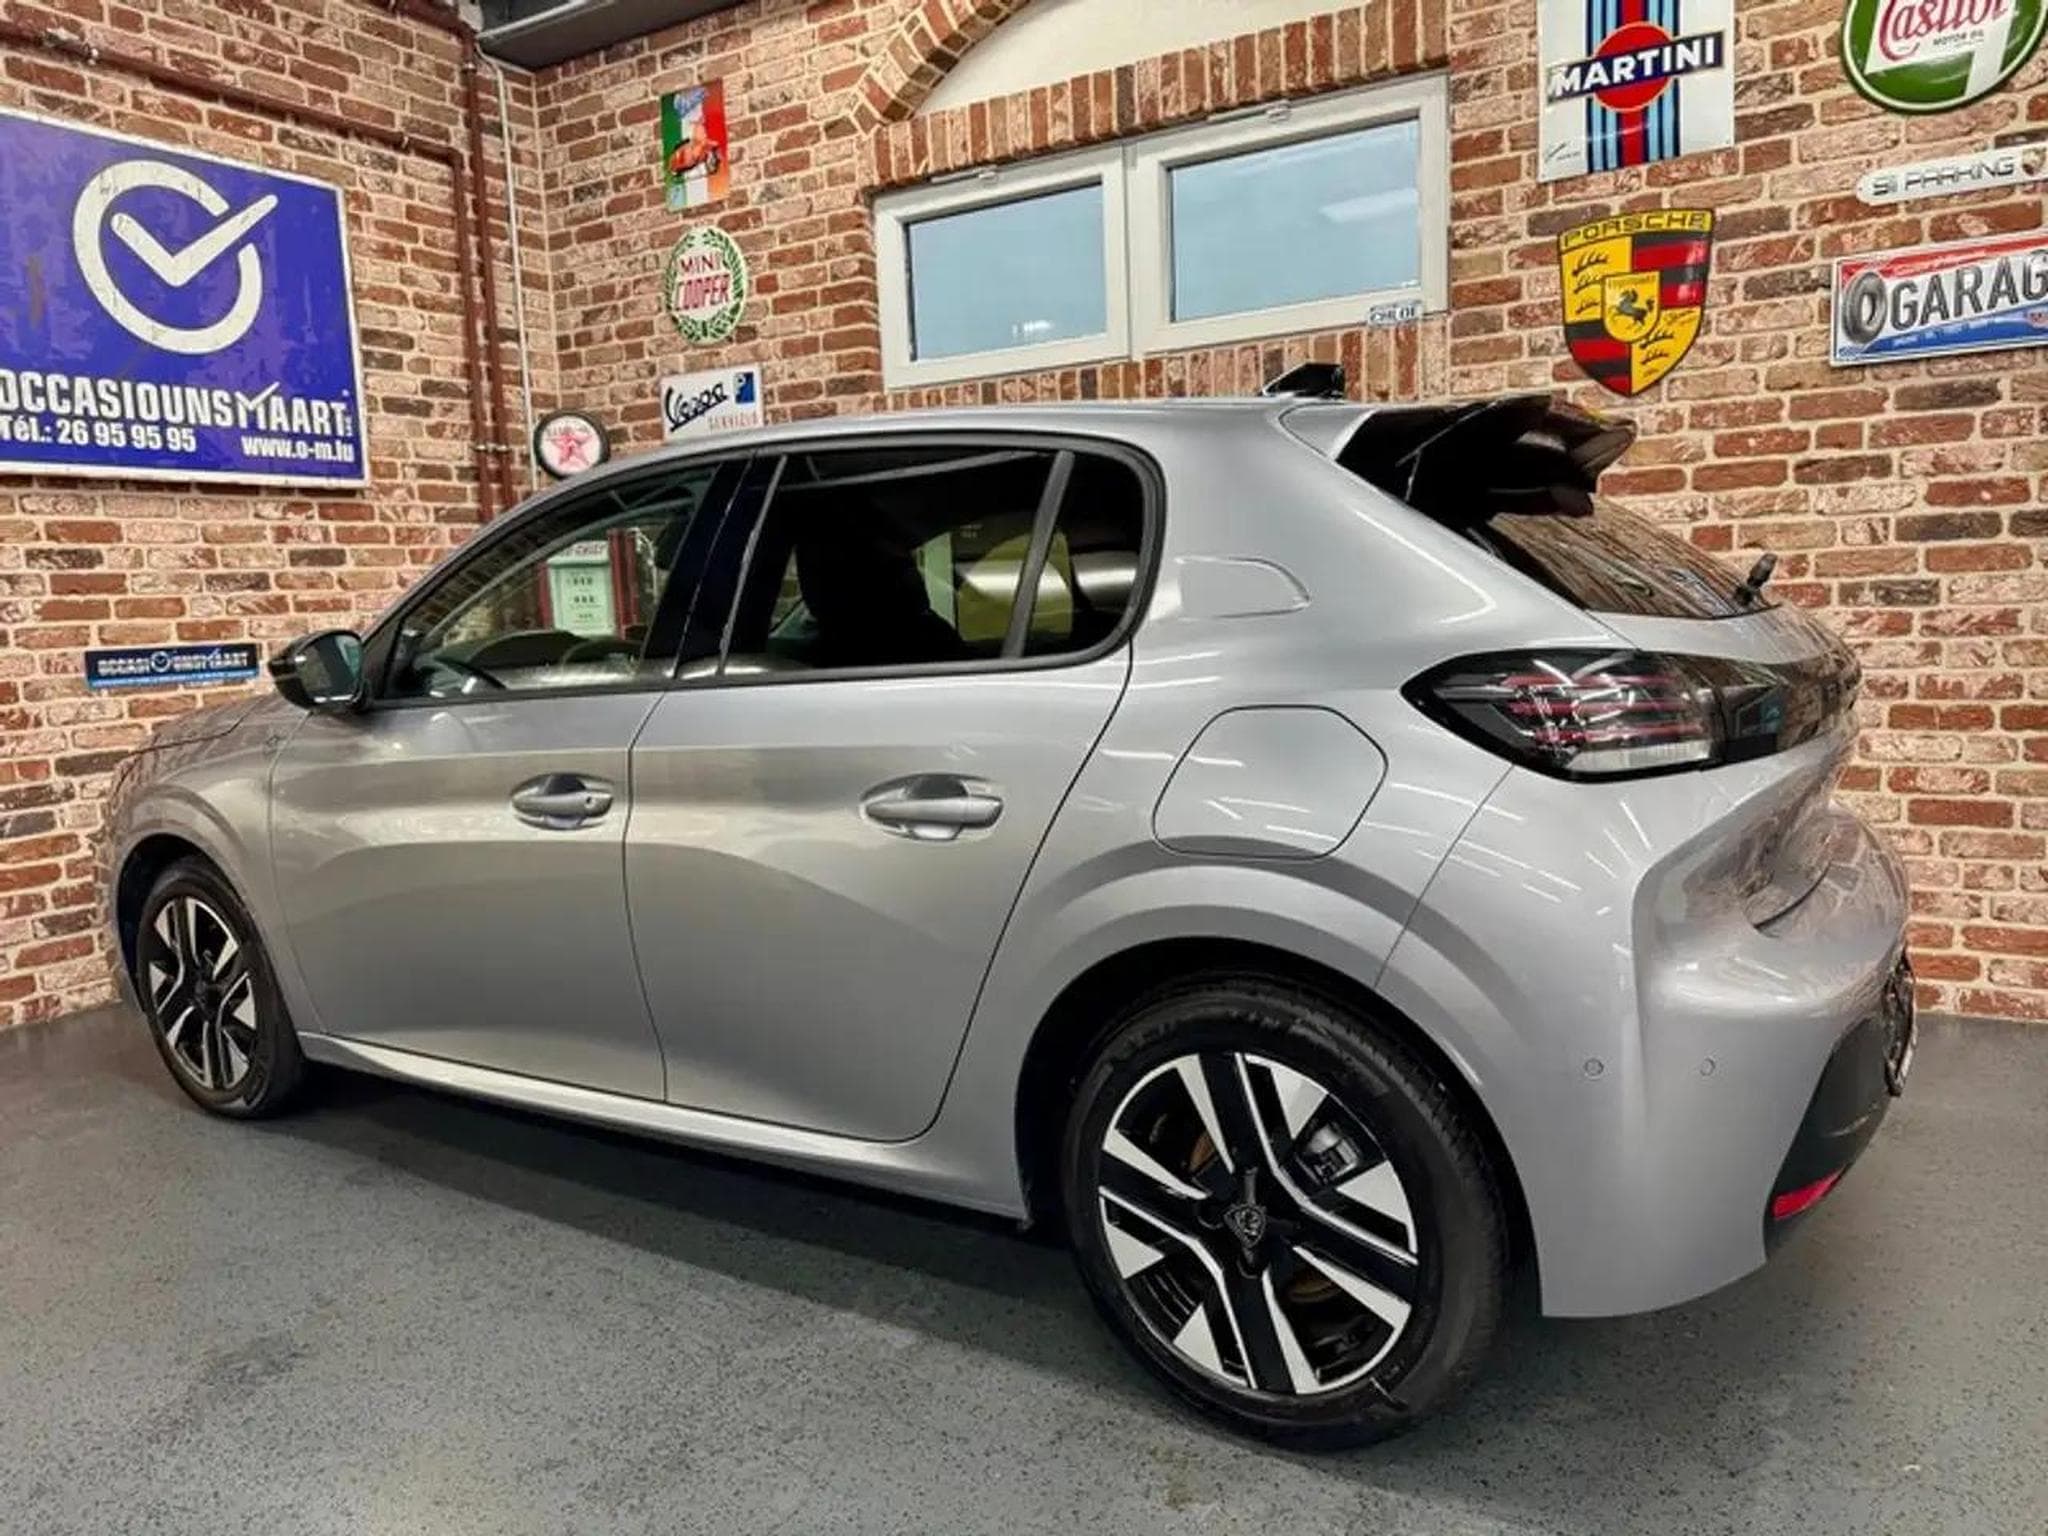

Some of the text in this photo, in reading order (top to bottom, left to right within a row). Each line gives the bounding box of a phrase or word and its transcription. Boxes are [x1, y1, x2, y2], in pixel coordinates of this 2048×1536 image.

[1550, 38, 1715, 96] MARTINI
[1905, 156, 2014, 190] PARKING
[1564, 213, 1706, 248] PORSCHE
[681, 252, 722, 273] MINI
[675, 274, 729, 311] COOPER
[0, 368, 347, 438] OCCASIOUNSMAART
[665, 383, 728, 432] Vespa
[0, 415, 197, 453] Tél.: 26 95 95 95
[241, 435, 355, 462] www.o-m.lu
